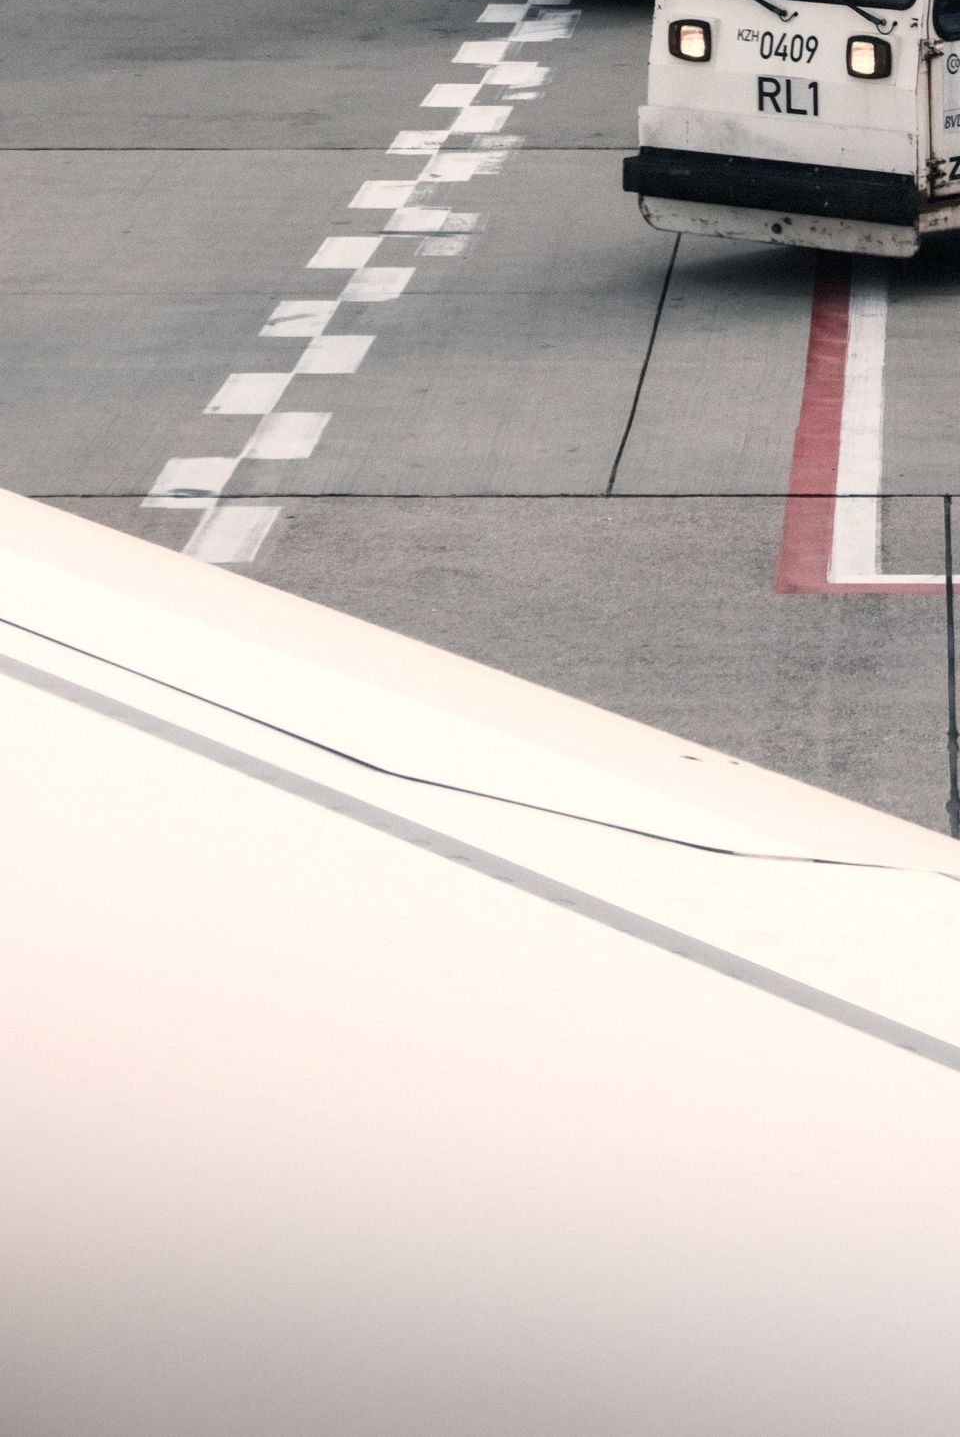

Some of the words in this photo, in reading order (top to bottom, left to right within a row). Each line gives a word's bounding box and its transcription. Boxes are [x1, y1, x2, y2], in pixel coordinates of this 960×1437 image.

[737, 29, 760, 43] KZH
[760, 31, 819, 64] 0409
[758, 76, 819, 117] RL1
